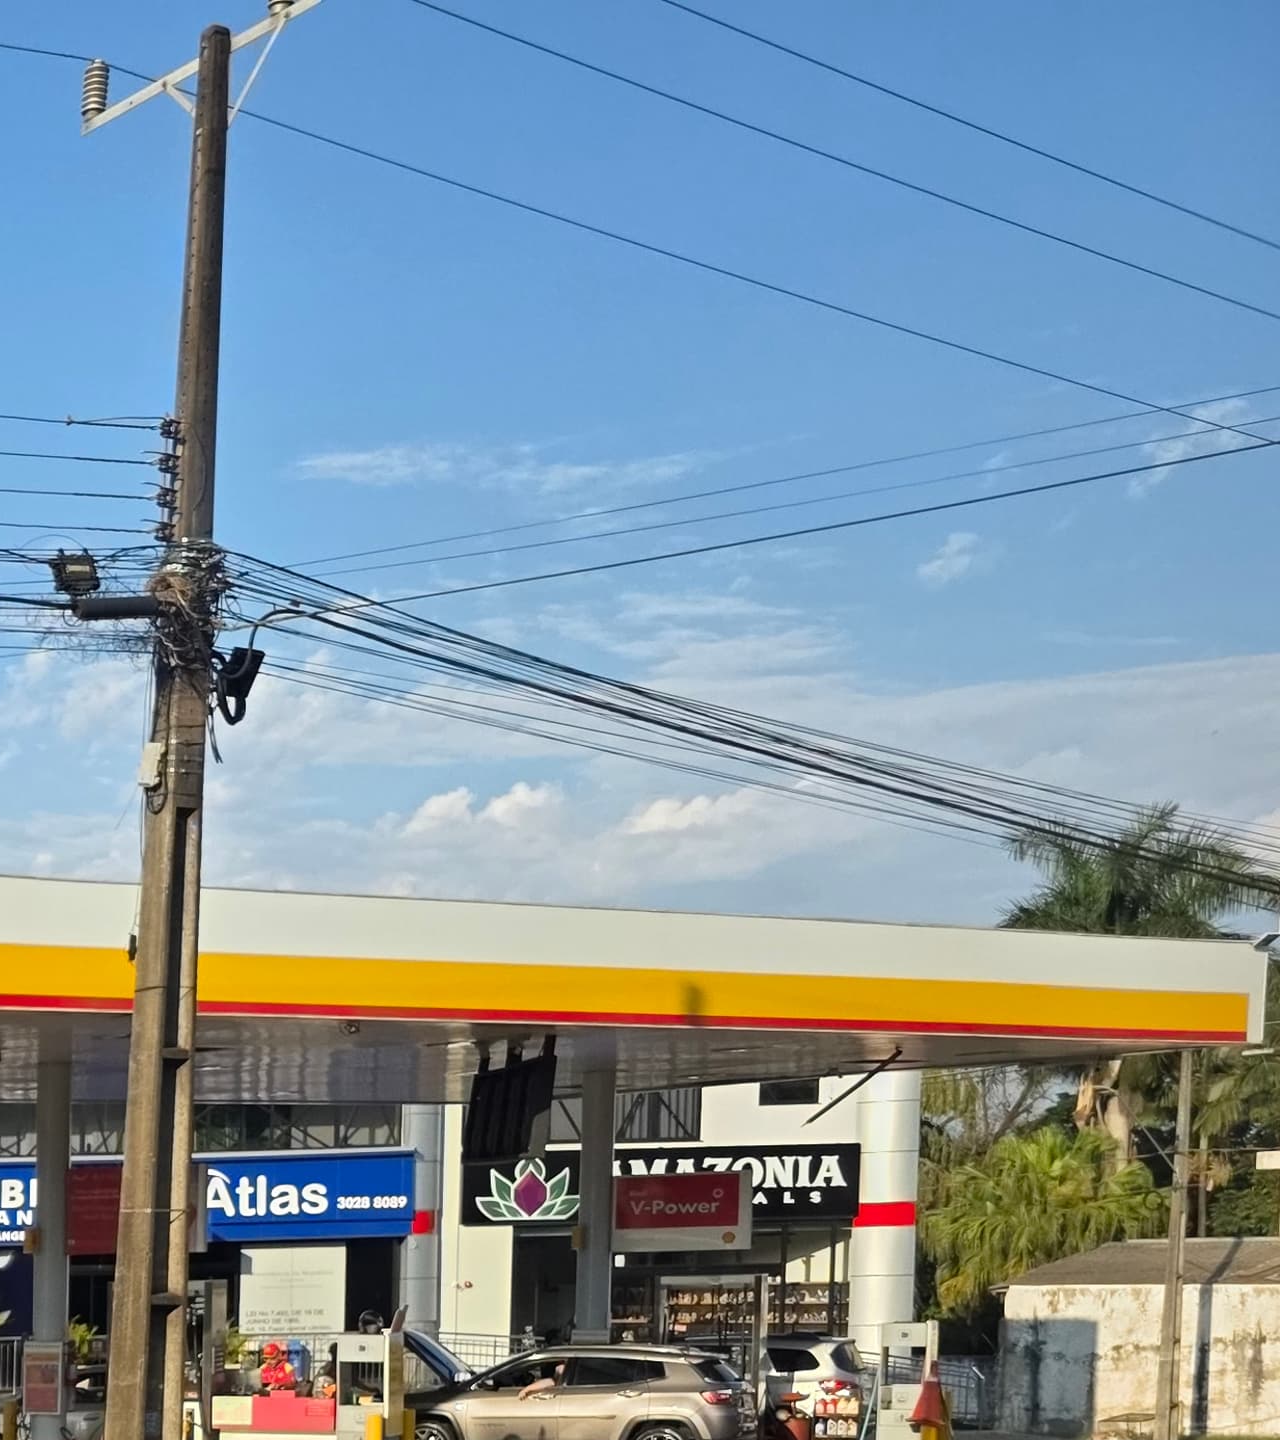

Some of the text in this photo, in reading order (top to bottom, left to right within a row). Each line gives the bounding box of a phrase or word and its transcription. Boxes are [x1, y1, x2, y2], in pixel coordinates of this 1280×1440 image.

[613, 1155, 848, 1188] MONIA
[336, 1196, 368, 1210] 3028
[629, 1199, 720, 1215] V-Power
